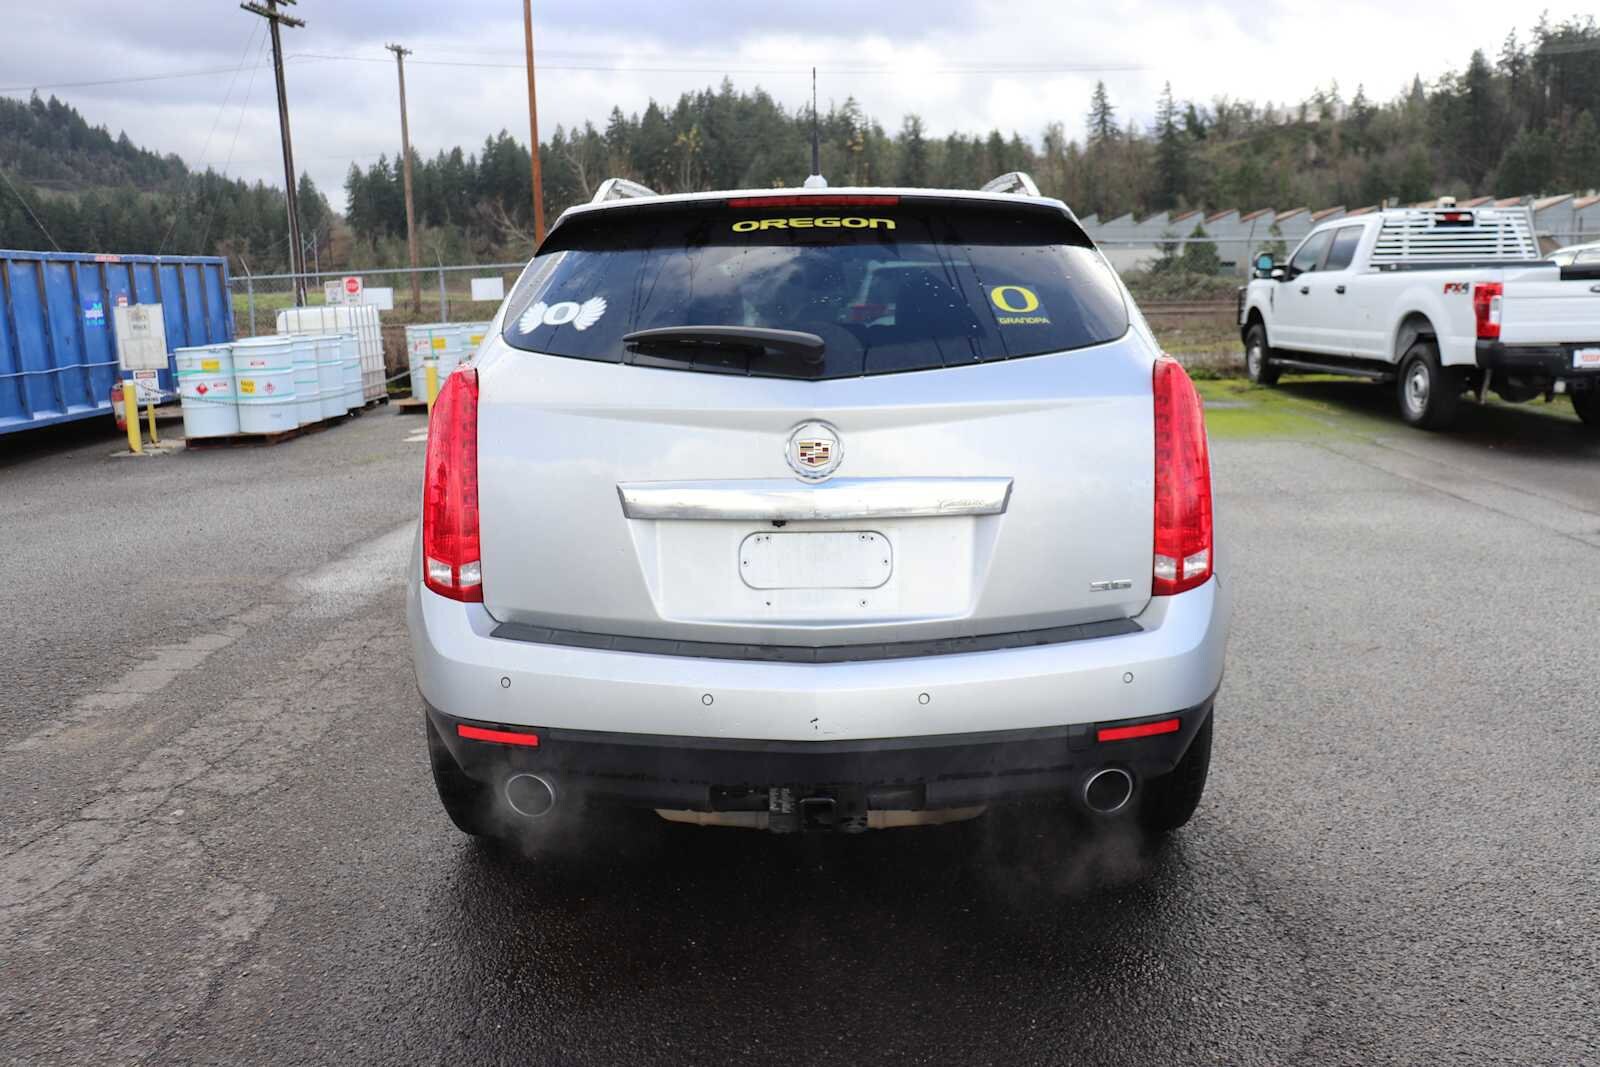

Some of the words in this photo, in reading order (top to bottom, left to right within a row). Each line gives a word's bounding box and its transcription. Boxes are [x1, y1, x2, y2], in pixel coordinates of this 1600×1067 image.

[732, 217, 896, 233] OREGON
[1443, 282, 1470, 295] FX4
[999, 317, 1051, 325] GRANDPA
